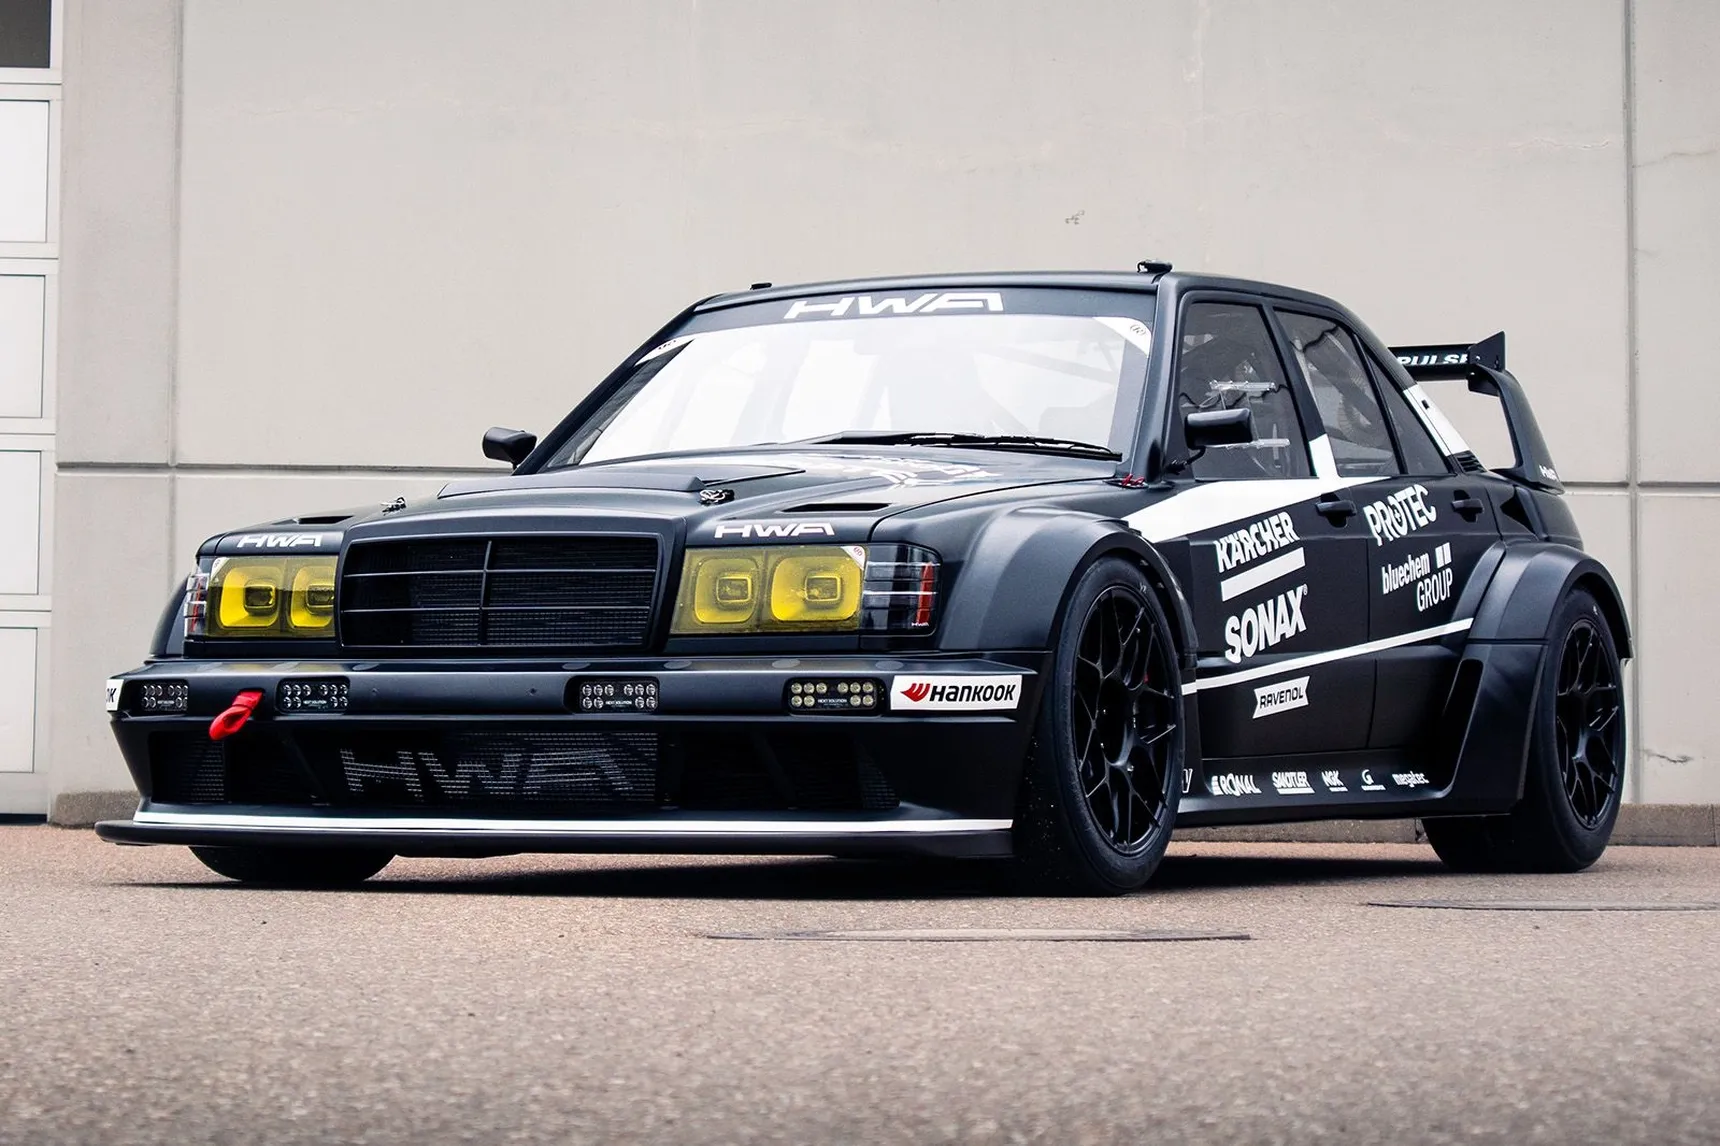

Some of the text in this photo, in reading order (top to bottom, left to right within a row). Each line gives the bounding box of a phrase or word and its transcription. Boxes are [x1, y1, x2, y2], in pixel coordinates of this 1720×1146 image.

[783, 292, 1004, 319] HWA
[714, 522, 836, 539] HWA
[1362, 484, 1437, 547] PROTEC
[236, 533, 324, 548] HWA
[1381, 553, 1431, 595] bluechem
[1416, 568, 1453, 612] GROUP
[1259, 687, 1304, 709] RAVENOL
[339, 748, 634, 798] HWA
